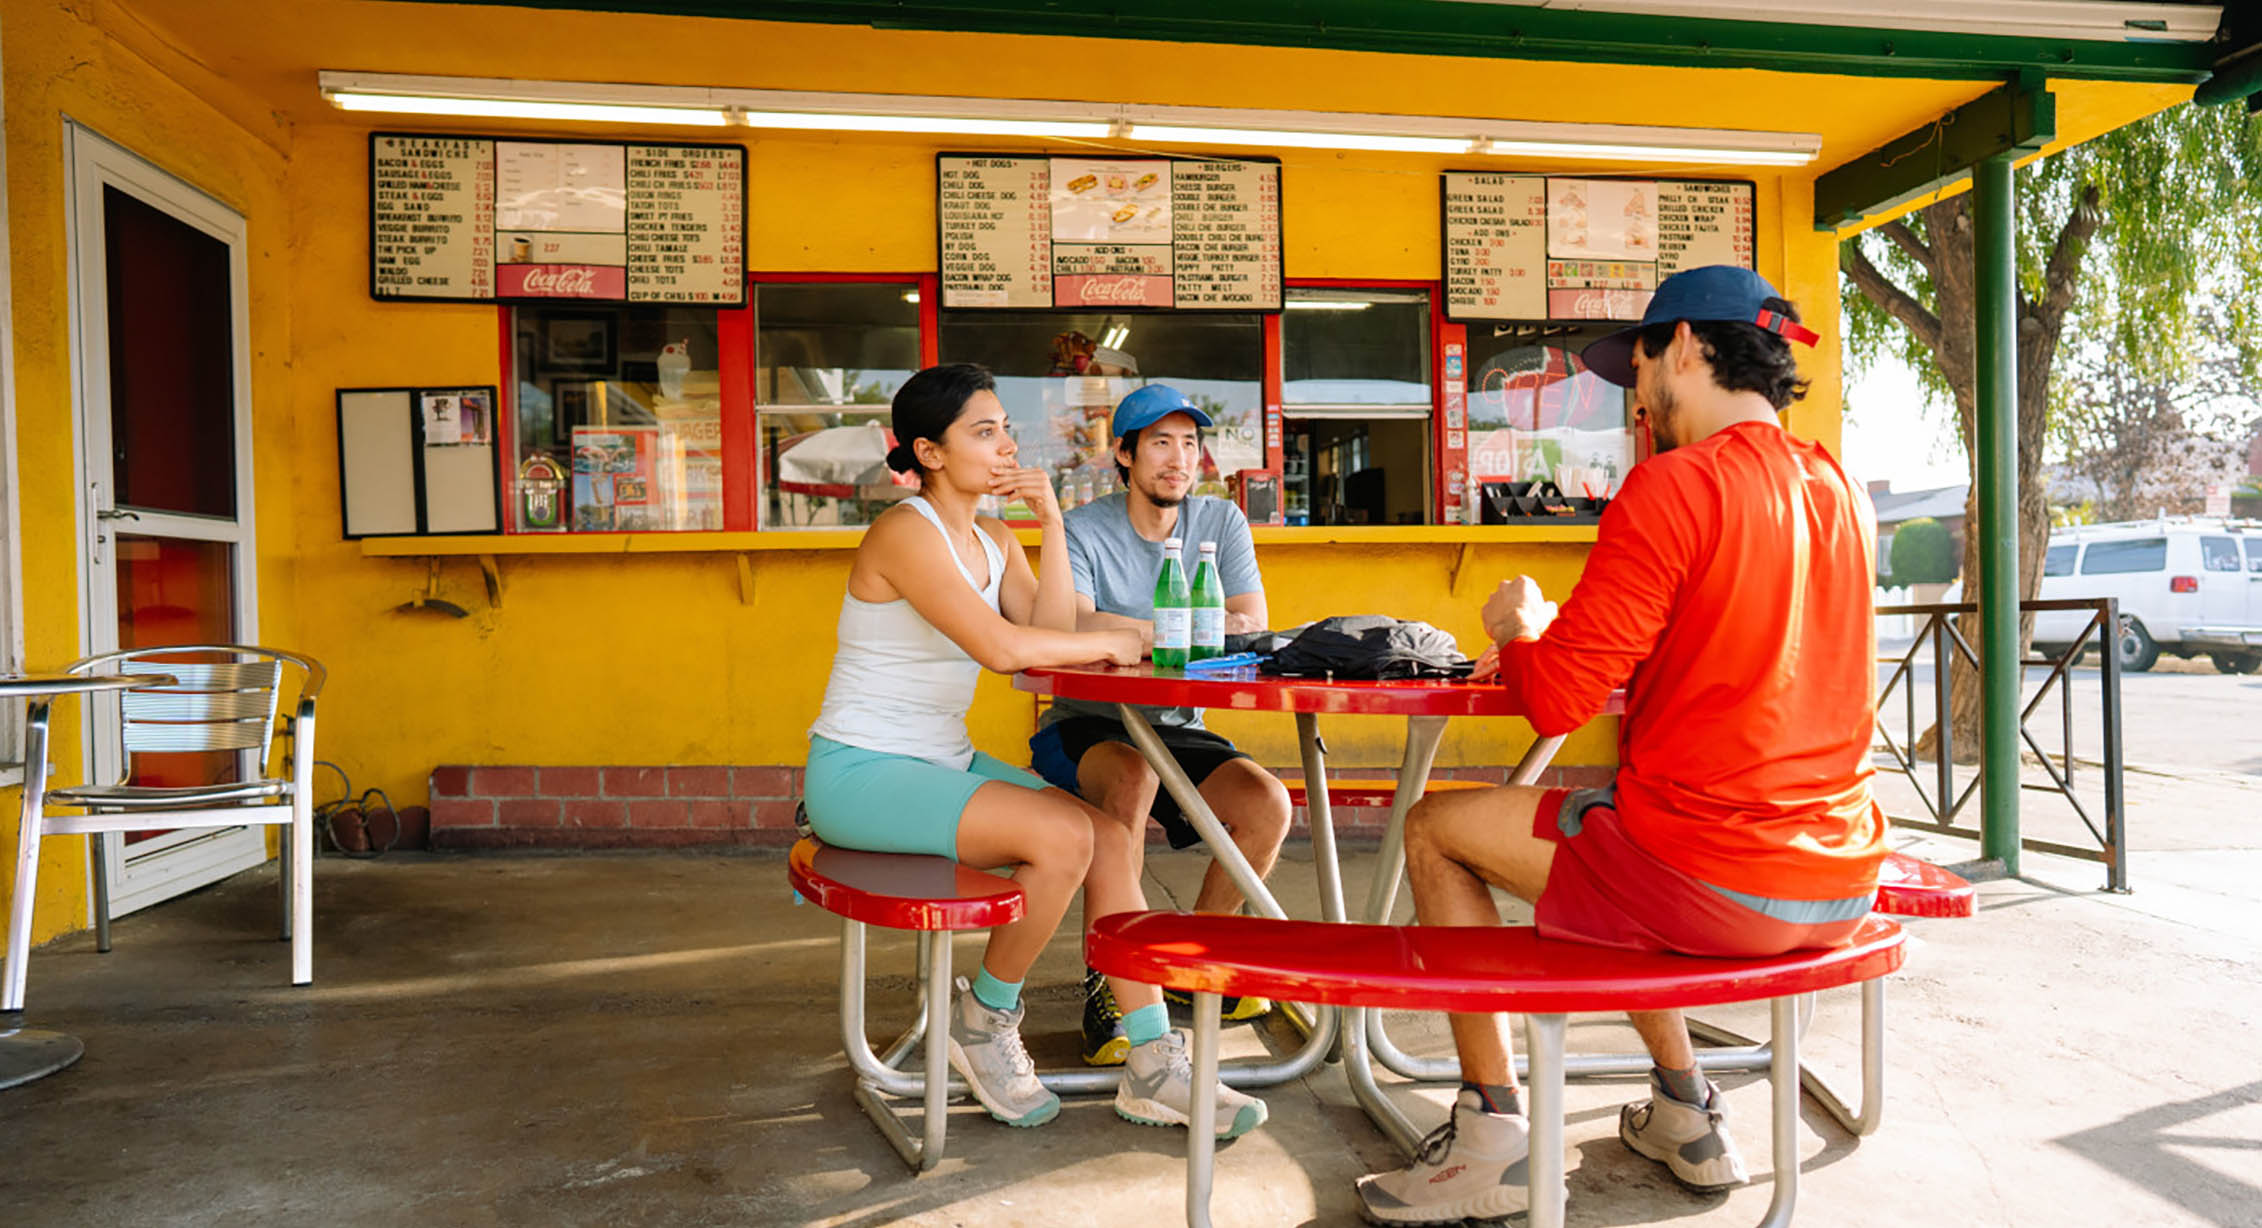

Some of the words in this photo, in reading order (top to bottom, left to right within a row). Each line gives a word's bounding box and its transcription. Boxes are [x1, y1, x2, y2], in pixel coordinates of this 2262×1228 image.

[646, 149, 668, 157] SIDE
[377, 159, 408, 167] BACON
[419, 160, 444, 169] EGGS
[631, 159, 661, 167] FRENCH
[664, 160, 686, 168] FRIES
[972, 159, 987, 167] HOT
[990, 159, 1012, 168] DOGS
[377, 170, 419, 178] SAUSAGE
[428, 171, 452, 180] EGGS
[630, 169, 651, 178] CHILI
[654, 170, 677, 178] FRIES
[963, 171, 980, 179] DOG
[943, 181, 964, 189] CHILI
[968, 181, 985, 189] DOG
[1474, 176, 1504, 185] SALAD
[1175, 183, 1202, 191] CHEESE
[1206, 183, 1235, 191] BURGER
[379, 191, 408, 200] STEAK
[421, 192, 443, 201] EGGS
[942, 191, 965, 199] CHILI
[967, 191, 995, 199] CHEESE
[1000, 192, 1016, 200] DOG
[1207, 193, 1236, 201] BURGER
[1476, 195, 1504, 203] SALAD
[377, 202, 394, 211] EGG
[403, 203, 430, 211] SAND
[944, 201, 970, 209] KRAUT
[974, 201, 991, 210] DOG
[1476, 206, 1504, 214] SALAD
[670, 212, 693, 221] FRIES
[1658, 214, 1689, 222] CHICKEN
[377, 223, 408, 232] VEGGIE
[412, 224, 449, 233] BURRITO
[630, 223, 665, 231] CHICKEN
[671, 223, 707, 231] TENDERS
[945, 222, 976, 230] TURKEY
[979, 222, 996, 230] DOG
[1659, 223, 1691, 231] CHICKEN
[378, 234, 405, 243] STEAK
[651, 233, 678, 242] CHEESE
[682, 233, 700, 242] TOTS
[945, 232, 973, 240] POLISH
[424, 246, 436, 254] UP
[958, 242, 976, 251] DOG
[1221, 243, 1249, 251] BURGER
[403, 257, 421, 265] EGG
[630, 254, 657, 263] CHEESE
[662, 254, 686, 263] FRIES
[944, 252, 967, 261] CORN
[972, 253, 990, 261] DOG
[1115, 256, 1139, 264] BACON
[630, 265, 659, 273] CHEESE
[664, 265, 684, 273] TOTS
[944, 262, 974, 271] VEGGIE
[979, 263, 996, 271] DOG
[417, 277, 449, 286] CHEESE
[655, 275, 676, 284] TOTS
[945, 273, 968, 281] BACON
[996, 274, 1012, 282] DOG
[1450, 277, 1476, 285] BACON
[988, 283, 1004, 291] DOG
[630, 291, 648, 299] CUP
[650, 291, 660, 299] OF
[1428, 1163, 1467, 1185] KEEN
